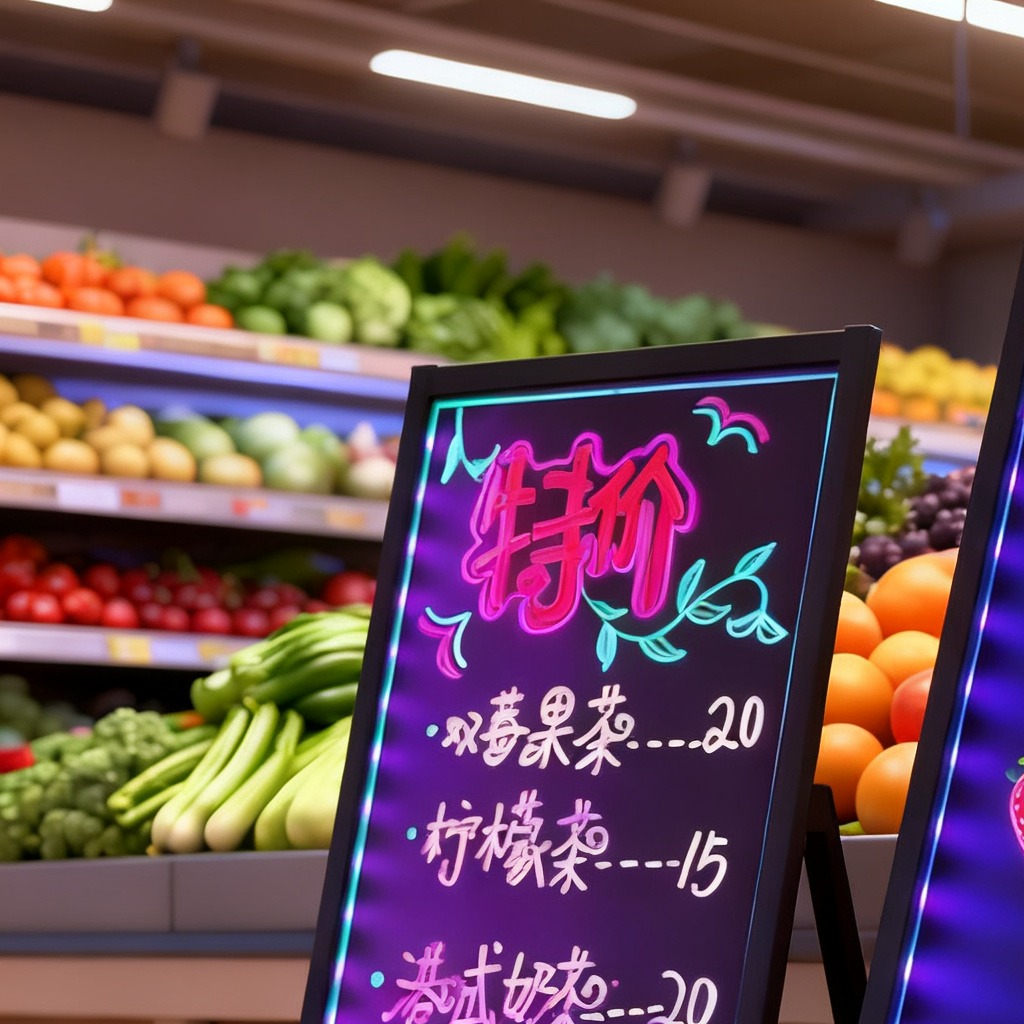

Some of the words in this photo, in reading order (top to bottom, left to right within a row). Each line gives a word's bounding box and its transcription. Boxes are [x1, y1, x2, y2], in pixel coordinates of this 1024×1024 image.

[462, 432, 698, 634] 特价
[702, 695, 766, 754] 20
[676, 830, 729, 898] 15
